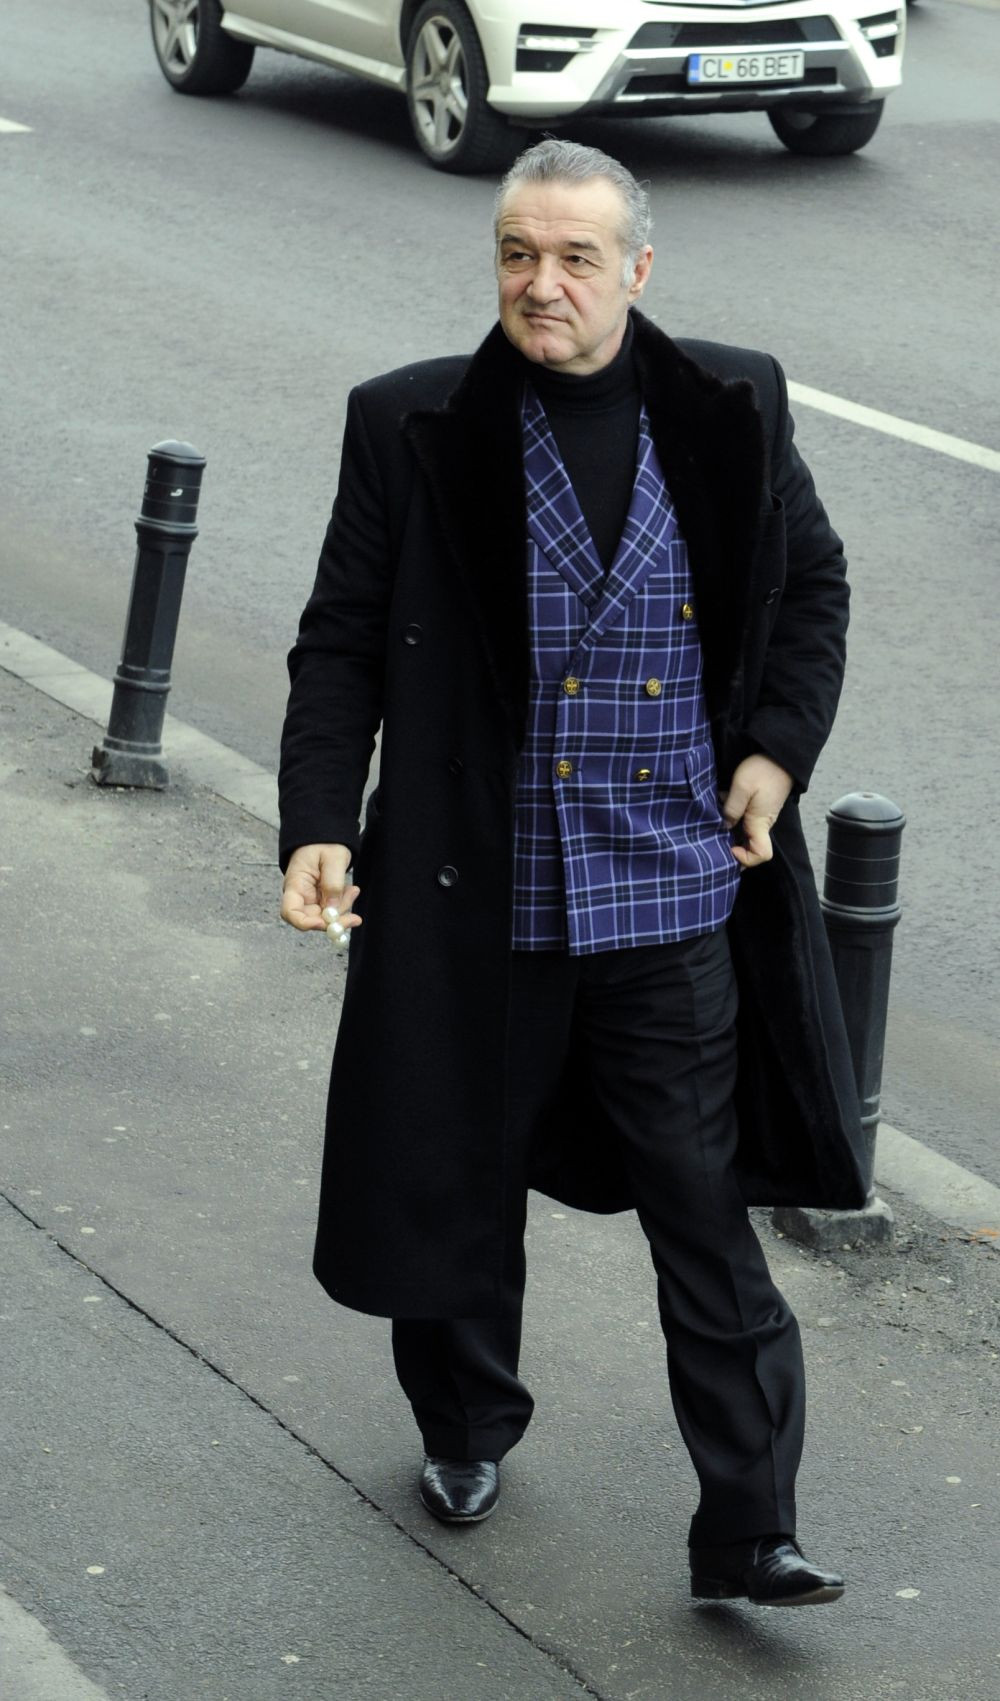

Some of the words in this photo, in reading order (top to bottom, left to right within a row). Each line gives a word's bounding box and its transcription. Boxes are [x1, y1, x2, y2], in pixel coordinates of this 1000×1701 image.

[703, 58, 729, 78] CL
[737, 58, 759, 78] 66
[764, 55, 800, 76] BET
